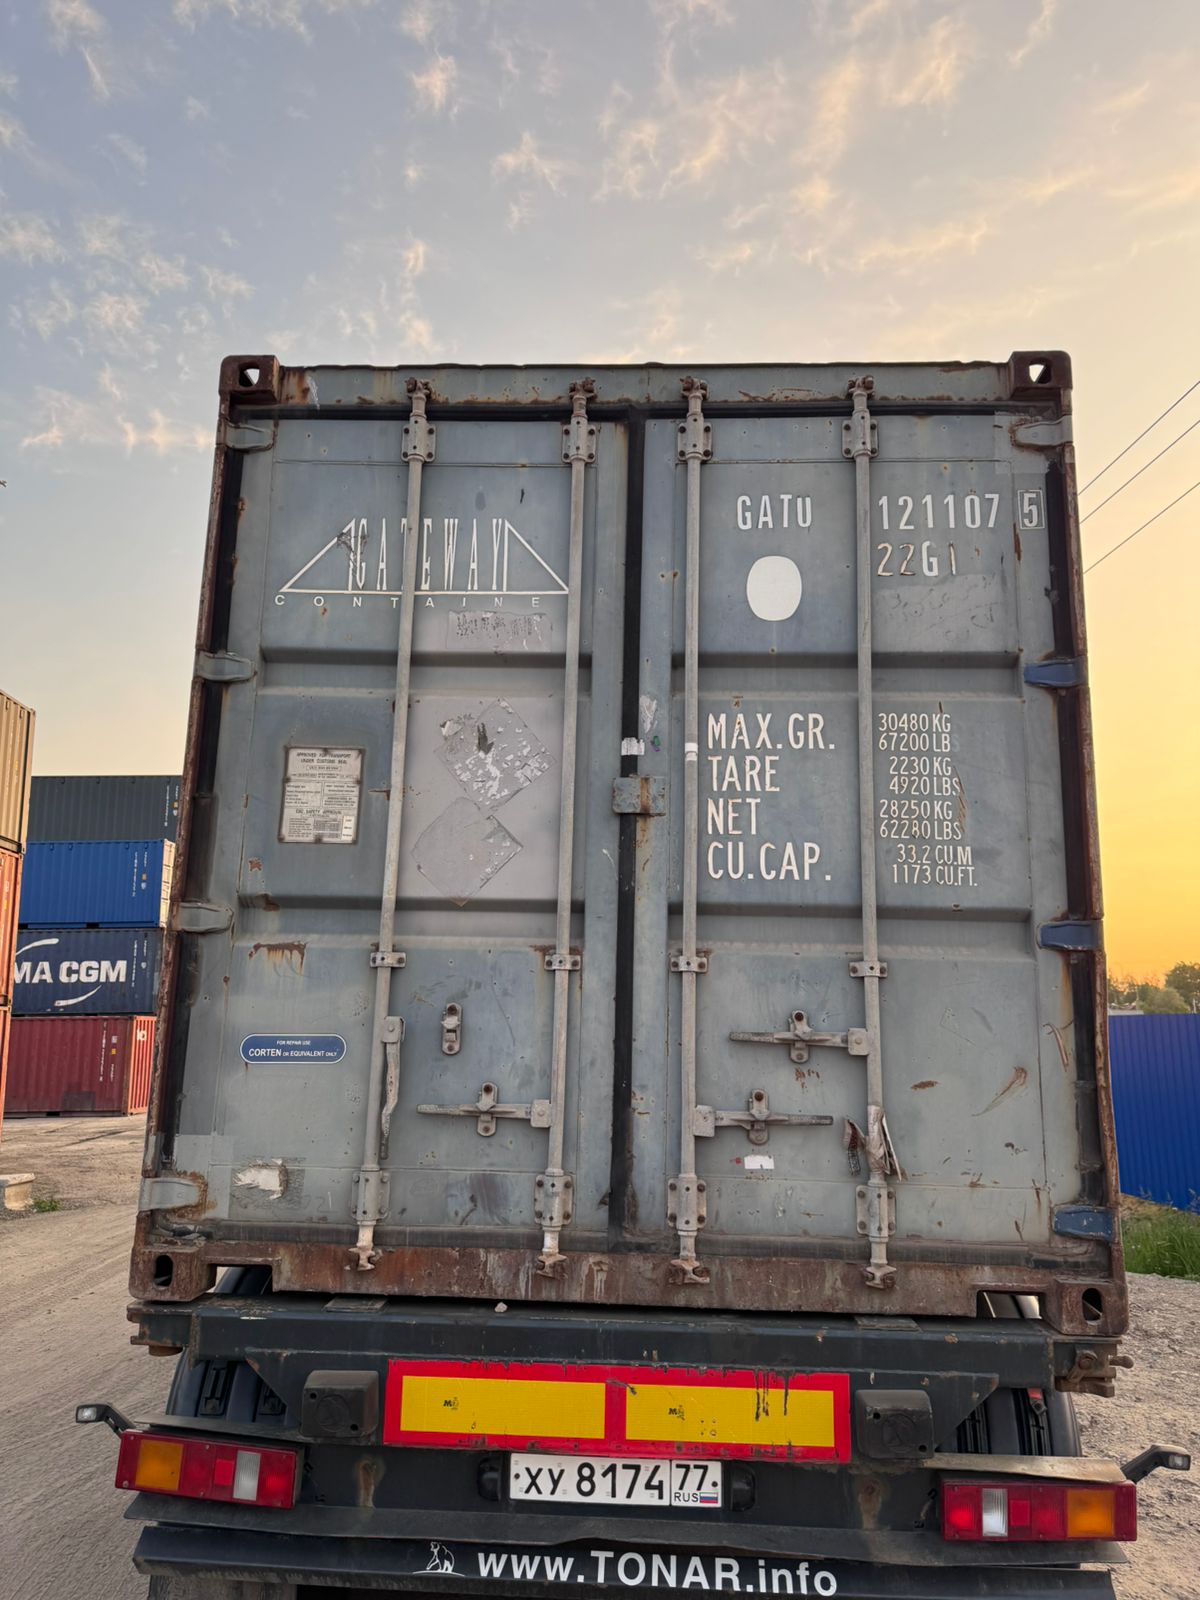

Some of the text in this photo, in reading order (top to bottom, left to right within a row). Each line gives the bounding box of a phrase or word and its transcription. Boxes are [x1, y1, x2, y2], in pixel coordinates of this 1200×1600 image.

[736, 494, 812, 530] GATU
[878, 493, 1038, 530] 121107 5
[707, 712, 835, 750] MAX.GR.
[878, 713, 951, 732] 30480 KG
[878, 733, 929, 752] 67200
[707, 755, 780, 792] TARE
[889, 756, 952, 775] 2230 KG
[889, 776, 961, 796] 4920 LBS
[707, 798, 761, 835] NET
[879, 800, 953, 820] 28250 KG
[879, 821, 962, 841] 62280 LBS
[707, 841, 832, 881] CU.CAP.
[897, 843, 973, 866] 33.2 CU.M
[892, 864, 932, 885] 1173
[14, 961, 54, 984] MA
[59, 960, 128, 983] CGM
[248, 1048, 281, 1057] CORTEN
[576, 1462, 664, 1500] 8174
[675, 1463, 709, 1491] 77
[674, 1492, 699, 1503] RUS
[477, 1550, 838, 1597] www.TONAR.info
